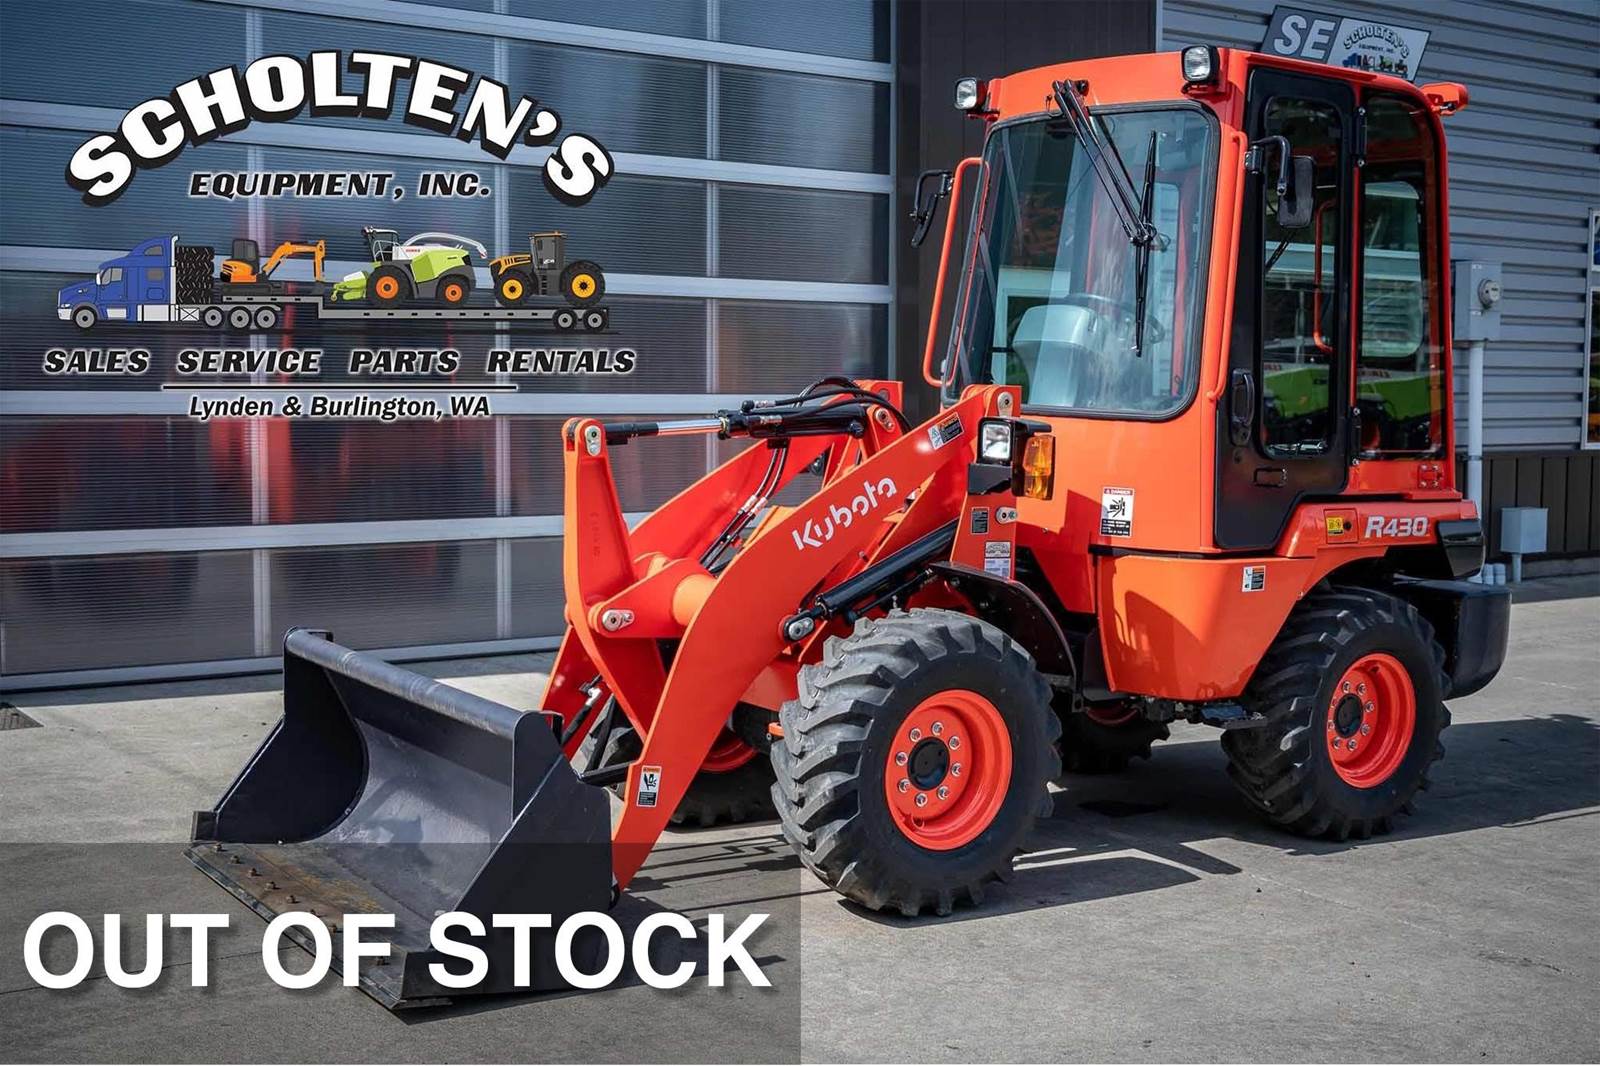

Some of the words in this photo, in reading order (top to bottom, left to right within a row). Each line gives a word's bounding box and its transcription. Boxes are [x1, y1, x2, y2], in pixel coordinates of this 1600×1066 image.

[1273, 14, 1337, 59] SE
[1343, 25, 1410, 60] SCHOLTEN'S
[791, 477, 898, 551] Kubota
[1364, 515, 1429, 539] R430
